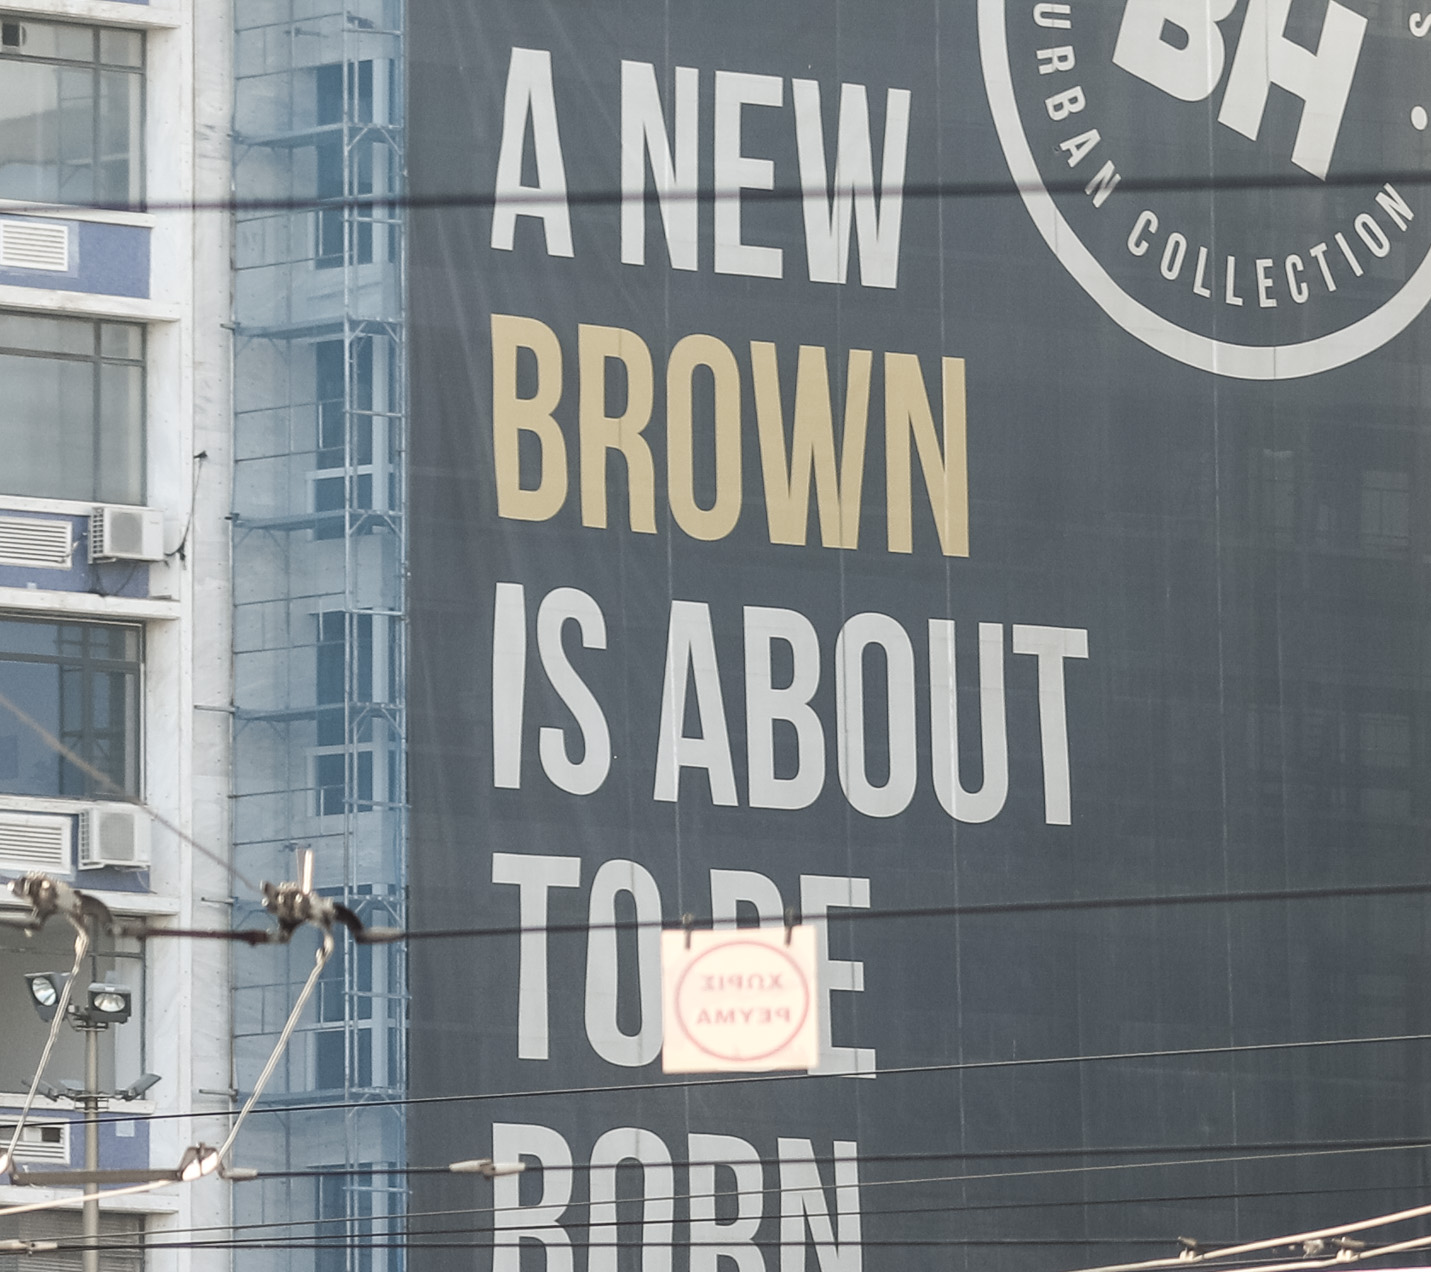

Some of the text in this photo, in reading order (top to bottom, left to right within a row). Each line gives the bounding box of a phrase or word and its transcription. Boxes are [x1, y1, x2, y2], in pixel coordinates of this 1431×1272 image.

[490, 46, 912, 290] A NEW
[1033, 2, 1122, 208] URBAN
[1126, 182, 1415, 308] COLLECTION
[490, 312, 970, 558] BROWN
[493, 581, 1089, 826] IS ABOUT
[491, 852, 663, 1068] TO
